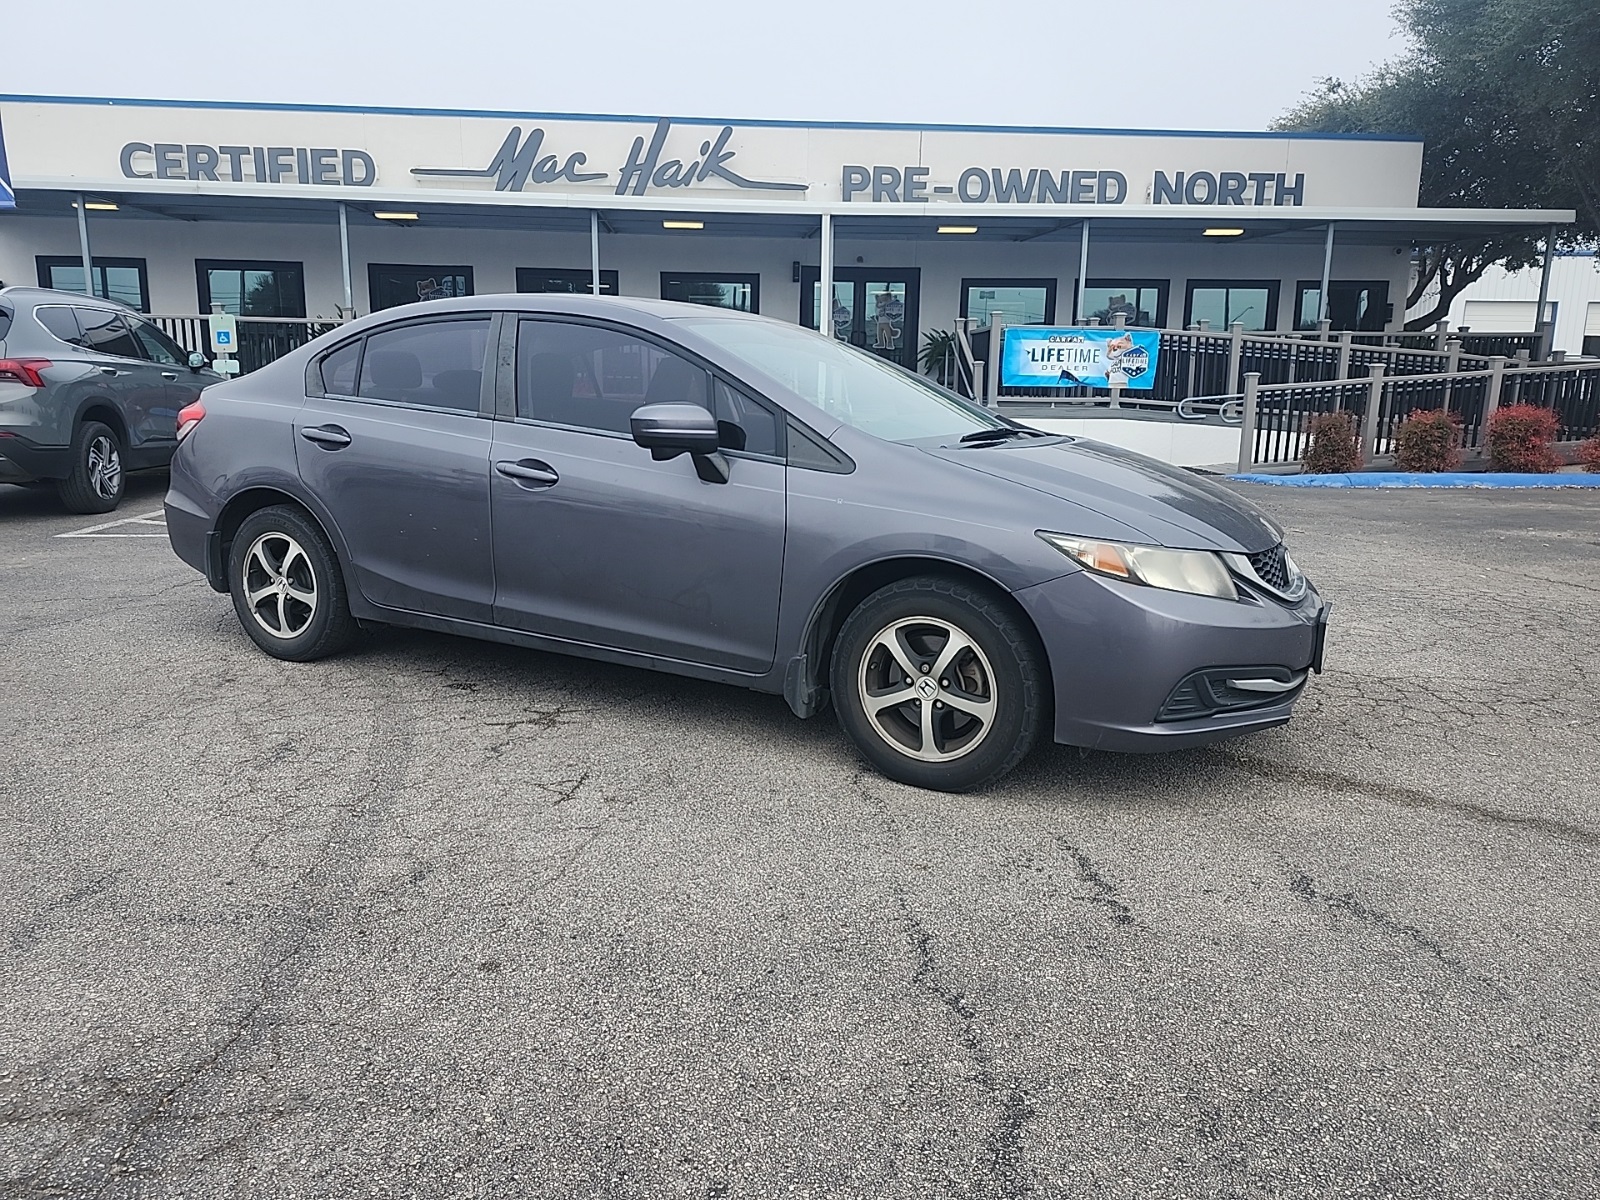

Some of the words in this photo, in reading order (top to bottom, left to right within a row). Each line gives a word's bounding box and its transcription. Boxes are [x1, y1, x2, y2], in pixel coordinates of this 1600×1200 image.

[120, 141, 376, 187] CERTIFIED
[615, 117, 808, 196] Haik
[842, 165, 1127, 204] PRE-OWNED
[1152, 169, 1305, 206] NORTH
[1030, 348, 1101, 364] LIFETIME
